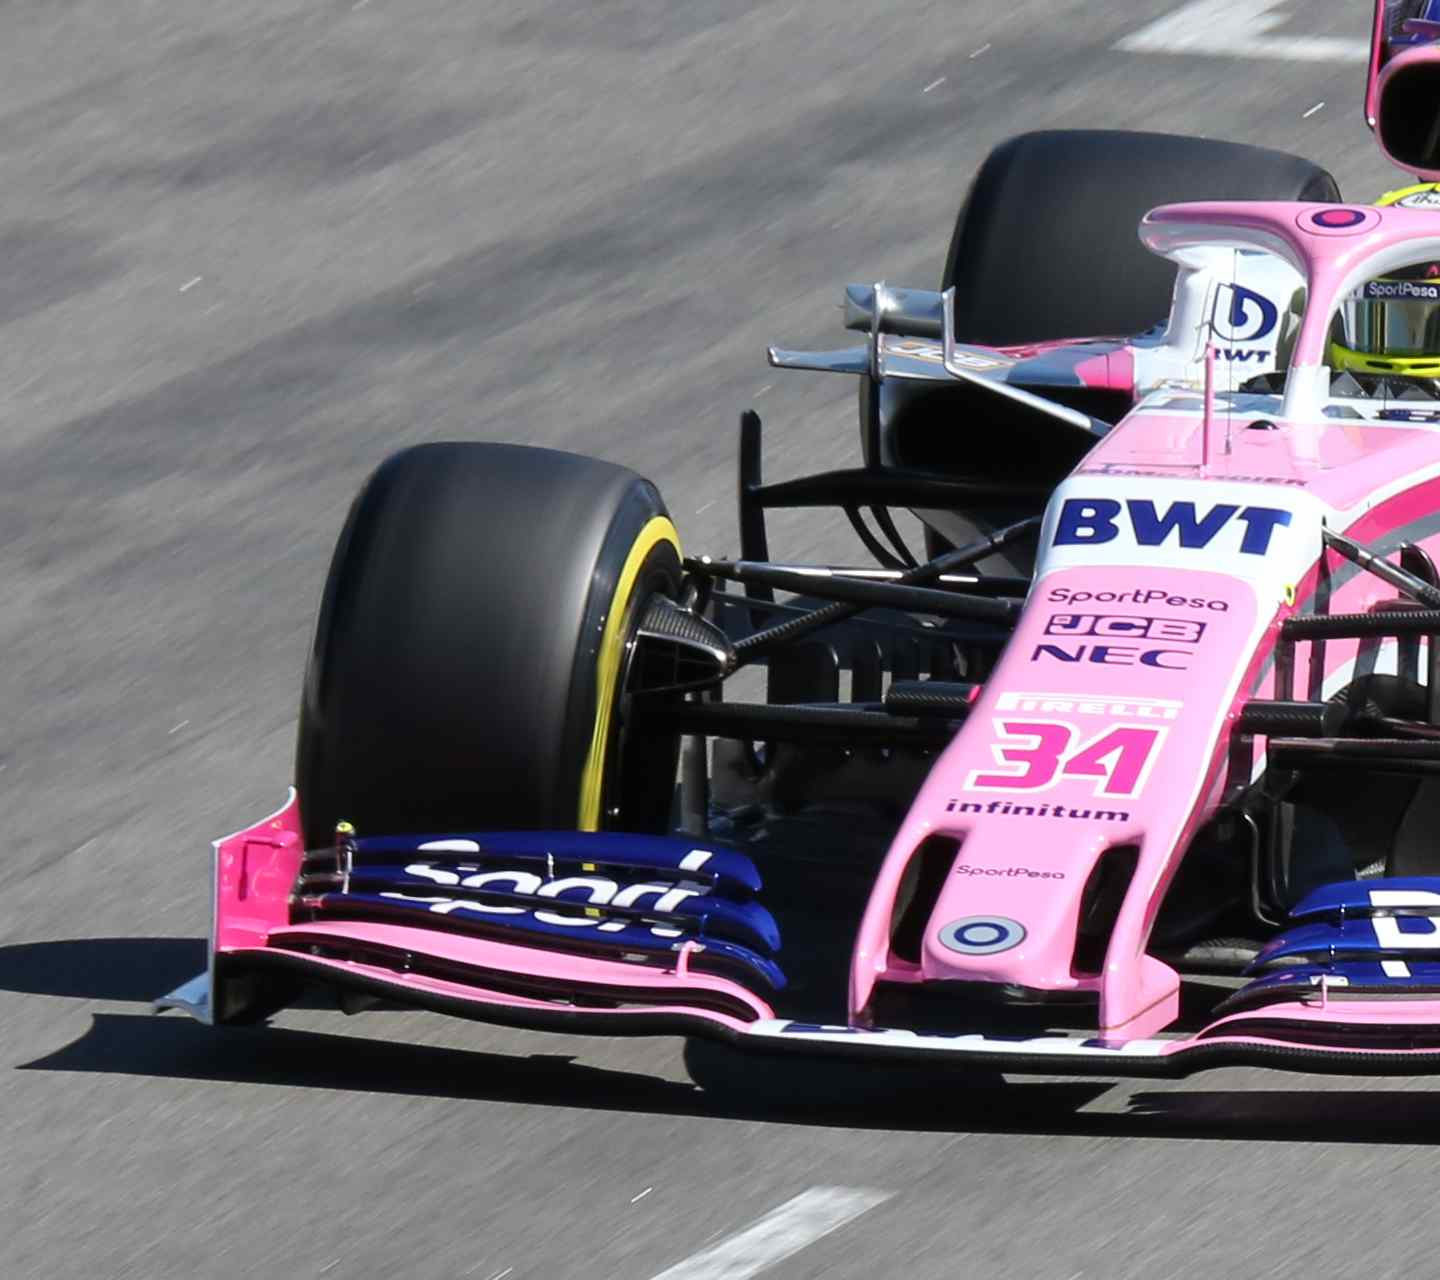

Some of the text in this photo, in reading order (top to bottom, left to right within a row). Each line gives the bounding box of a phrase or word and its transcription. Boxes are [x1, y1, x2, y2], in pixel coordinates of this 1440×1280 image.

[1368, 282, 1439, 298] SportPesa
[1053, 499, 1292, 556] BWT
[1047, 588, 1229, 612] SportPesa
[1043, 614, 1207, 643] JCB
[1030, 644, 1194, 670] NEC
[994, 692, 1184, 720] PIRELLI
[964, 718, 1168, 799] 34
[946, 799, 1129, 821] infinitum
[956, 864, 1066, 880] SportPesa
